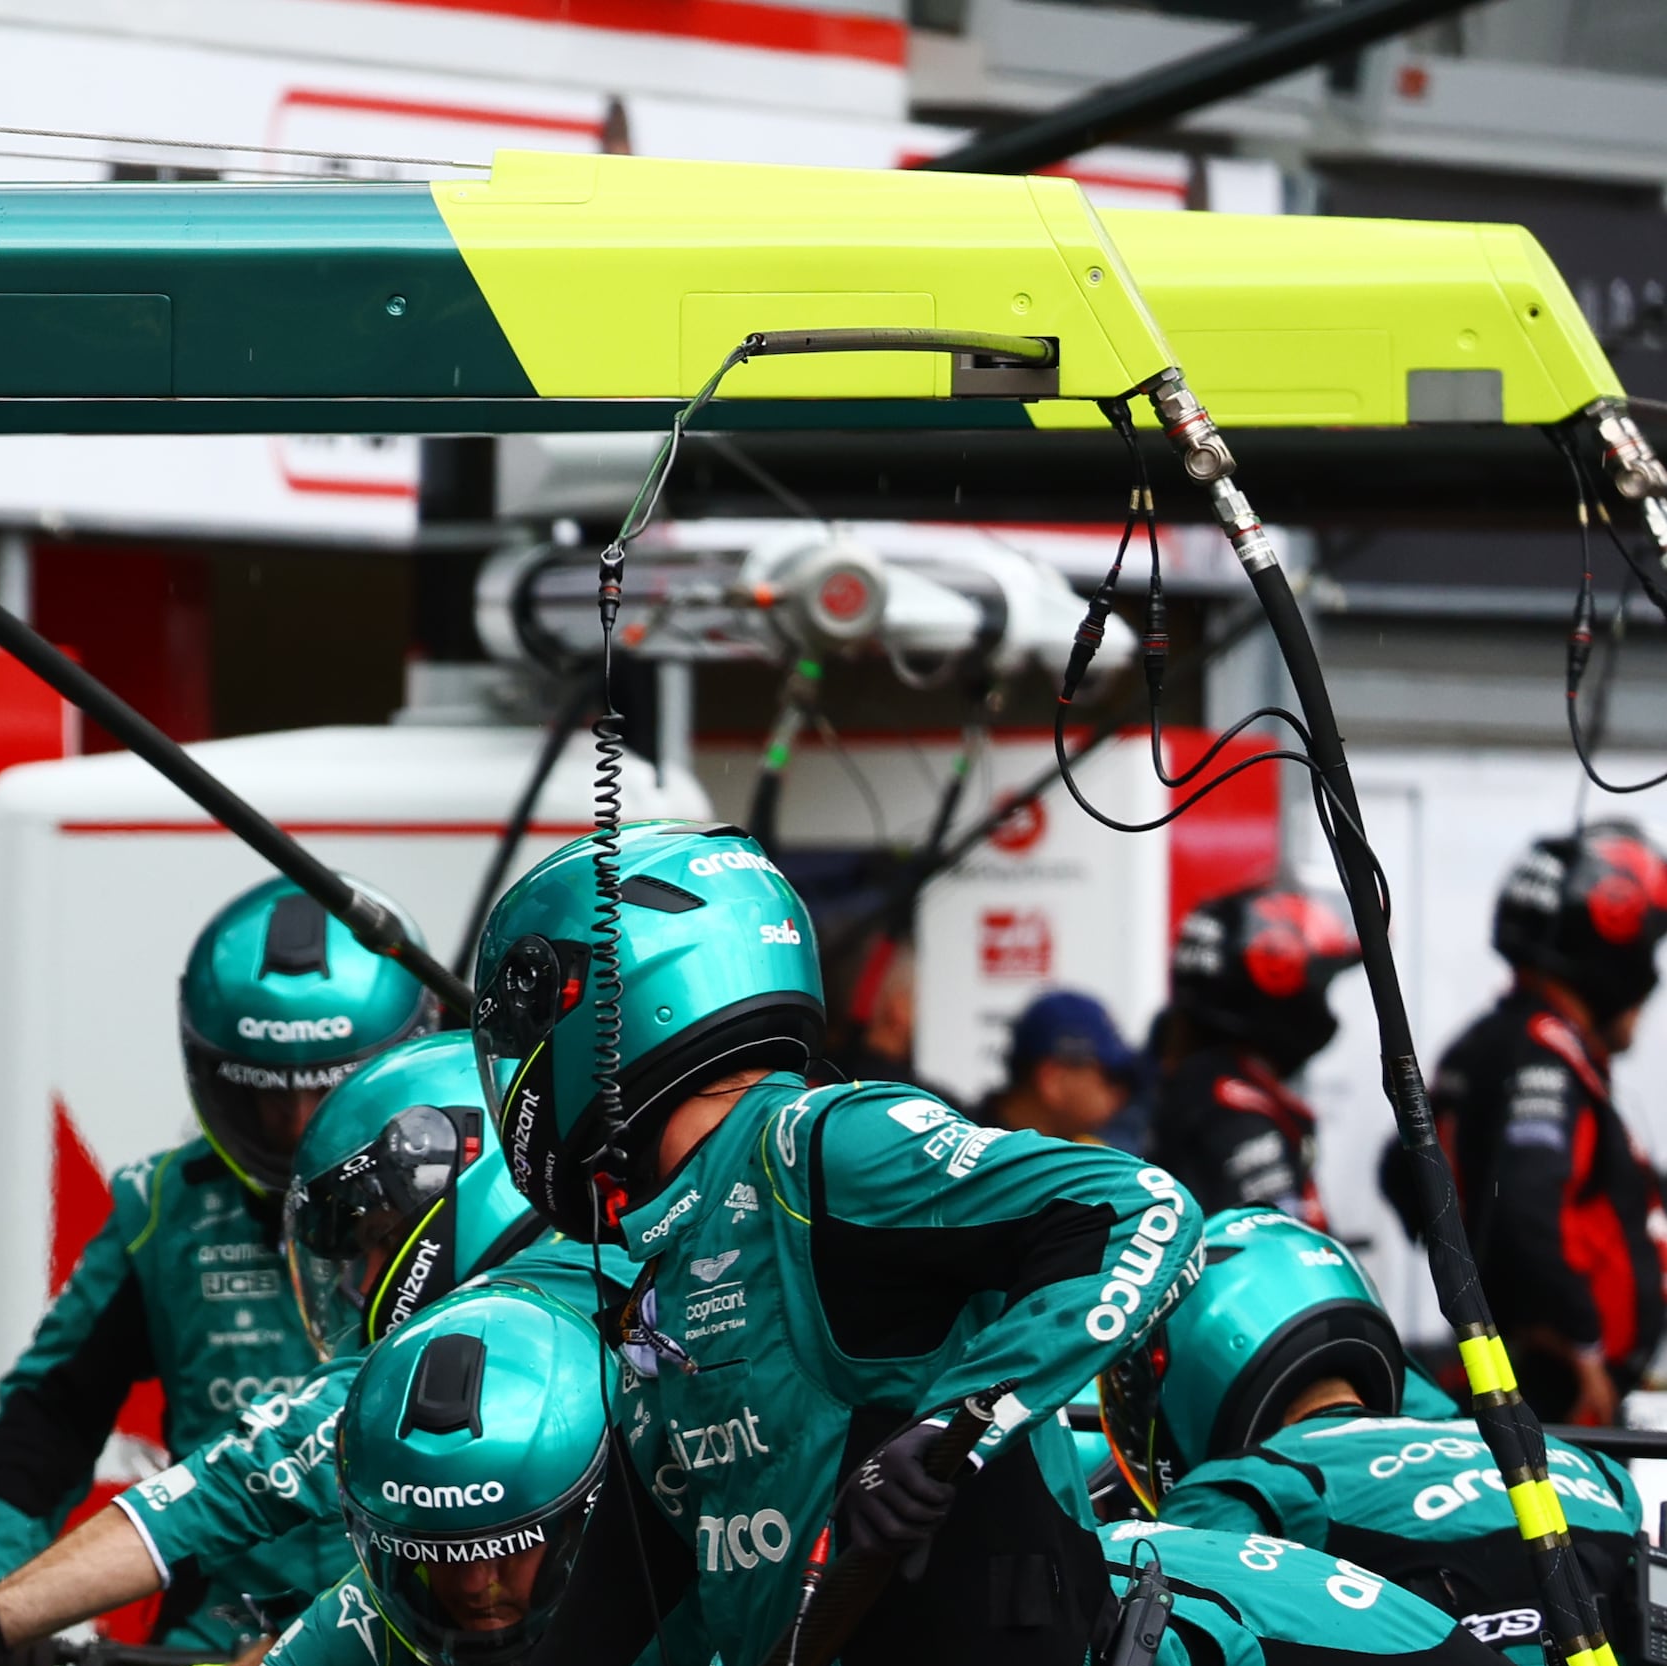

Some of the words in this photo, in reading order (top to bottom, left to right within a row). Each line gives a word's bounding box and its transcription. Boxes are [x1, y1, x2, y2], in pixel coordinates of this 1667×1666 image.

[759, 919, 801, 946] Stilo
[238, 1015, 352, 1043] aramco
[217, 1061, 289, 1091] ASTON
[510, 1088, 541, 1193] cognizant
[641, 1189, 702, 1244] cognizant
[1085, 1167, 1186, 1341] aramco
[685, 1288, 747, 1322] cognizant
[381, 1479, 505, 1509] aramco
[369, 1529, 440, 1563] ASTON
[445, 1524, 546, 1564] MARTIN
